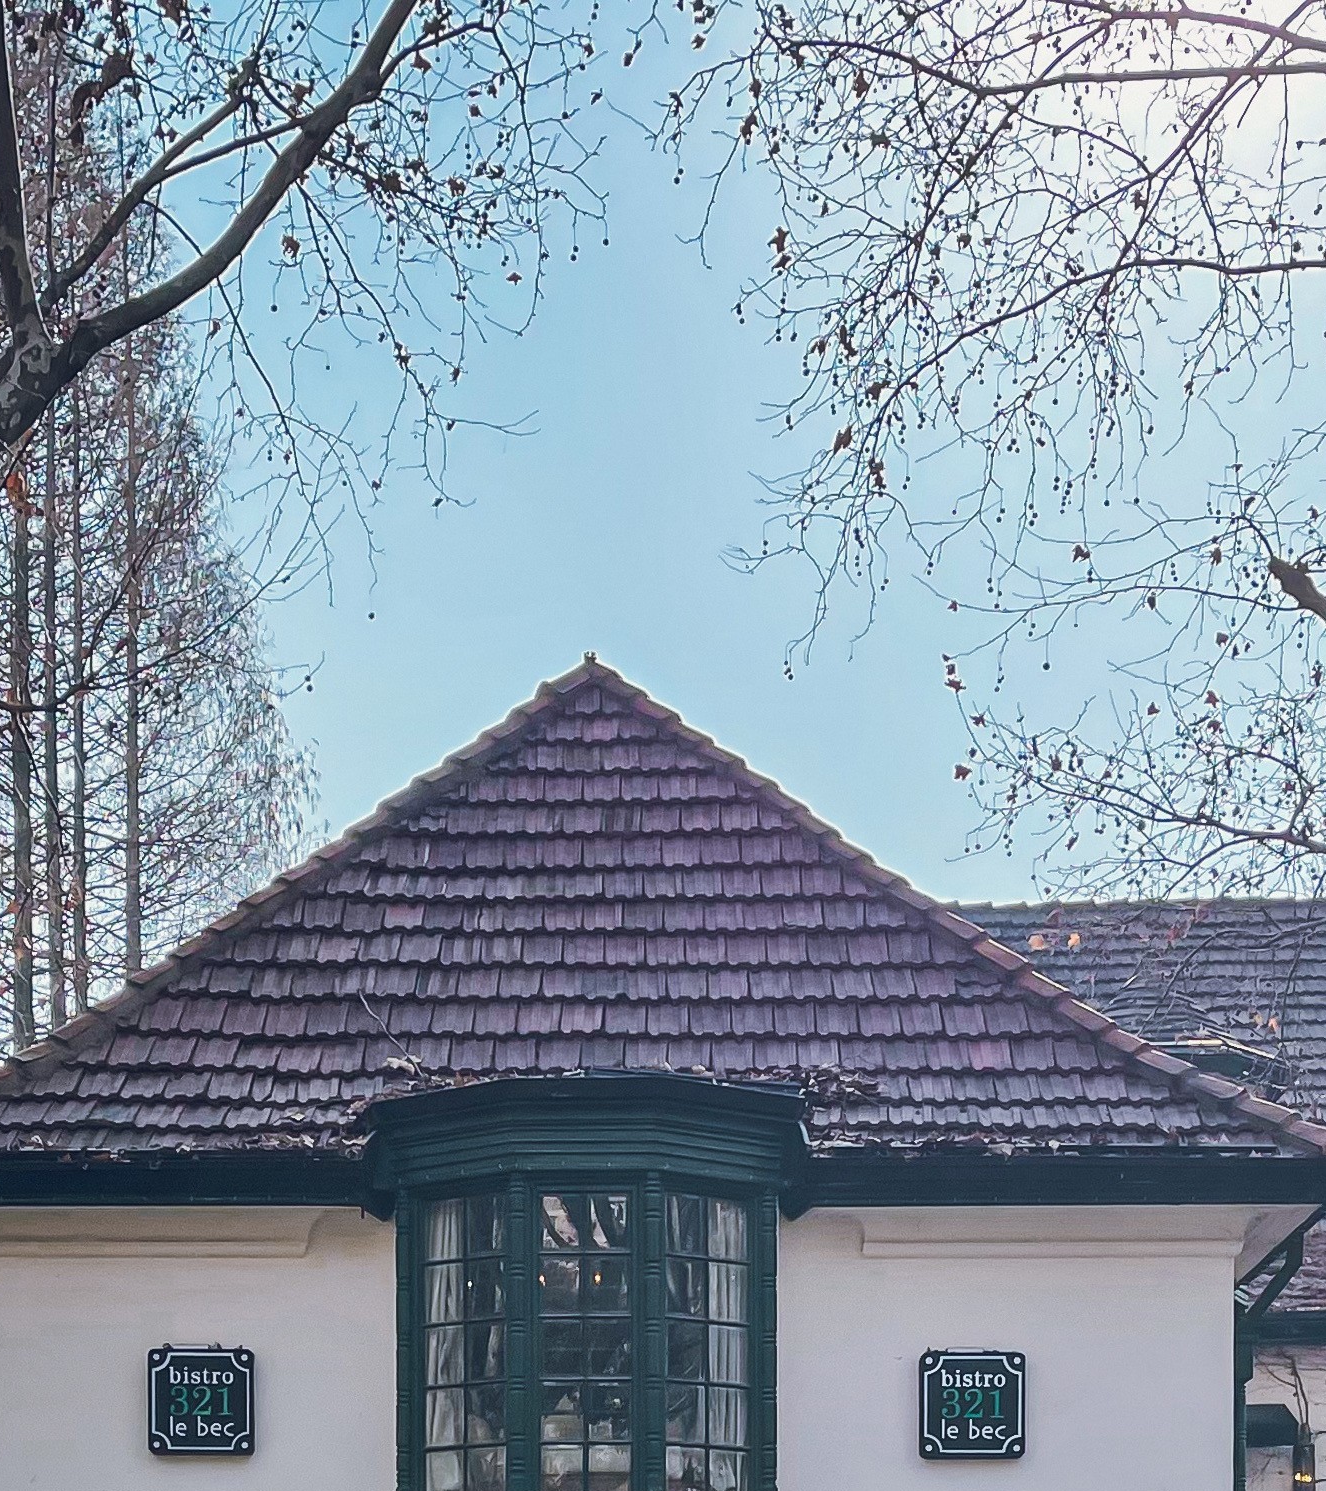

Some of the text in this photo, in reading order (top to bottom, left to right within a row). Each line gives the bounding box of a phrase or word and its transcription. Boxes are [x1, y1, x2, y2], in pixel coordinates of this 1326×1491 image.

[169, 1366, 234, 1385] bistro
[941, 1369, 1006, 1388] bistro
[170, 1386, 233, 1416] 321
[941, 1388, 1005, 1419] 321
[169, 1415, 235, 1437] le bec
[941, 1418, 1007, 1440] le bec
